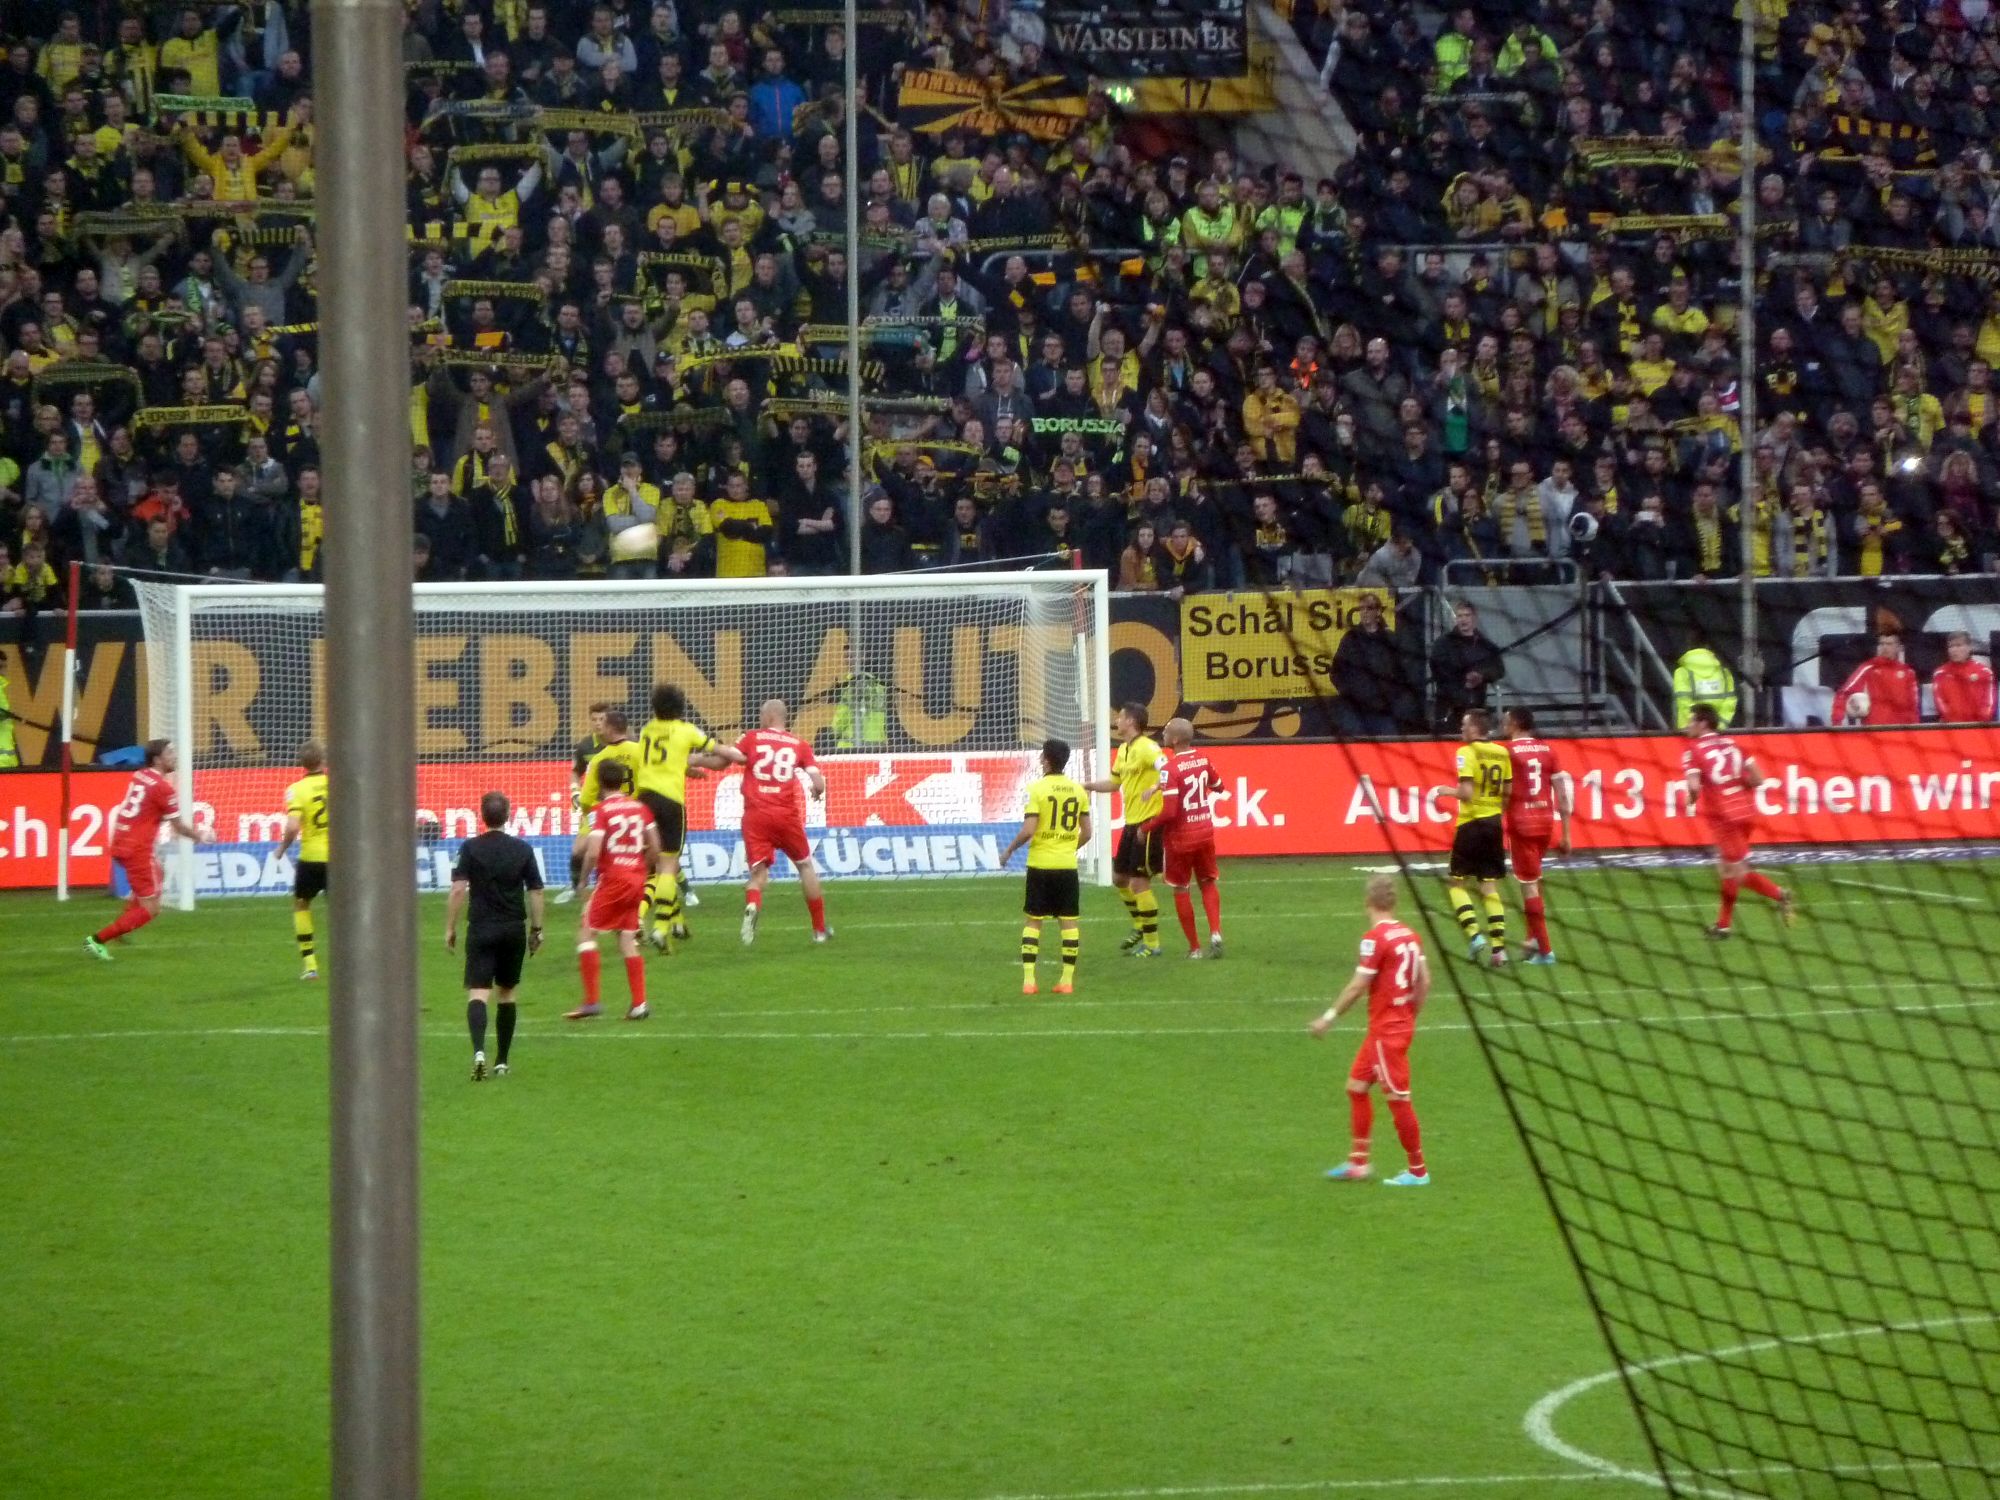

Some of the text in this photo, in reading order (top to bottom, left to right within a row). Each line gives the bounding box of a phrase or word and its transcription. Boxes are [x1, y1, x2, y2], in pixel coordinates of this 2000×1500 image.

[1052, 22, 1239, 50] WARSTEINER
[1180, 79, 1211, 110] 17
[1031, 417, 1127, 435] BORUSSIA
[1206, 651, 1331, 680] Boruss
[642, 735, 671, 766] 15
[752, 744, 797, 783] 28
[1479, 763, 1503, 798] 19
[1527, 757, 1542, 796] 3
[1047, 795, 1080, 832] 18
[1343, 774, 1453, 825] Auc
[607, 813, 646, 855] 23
